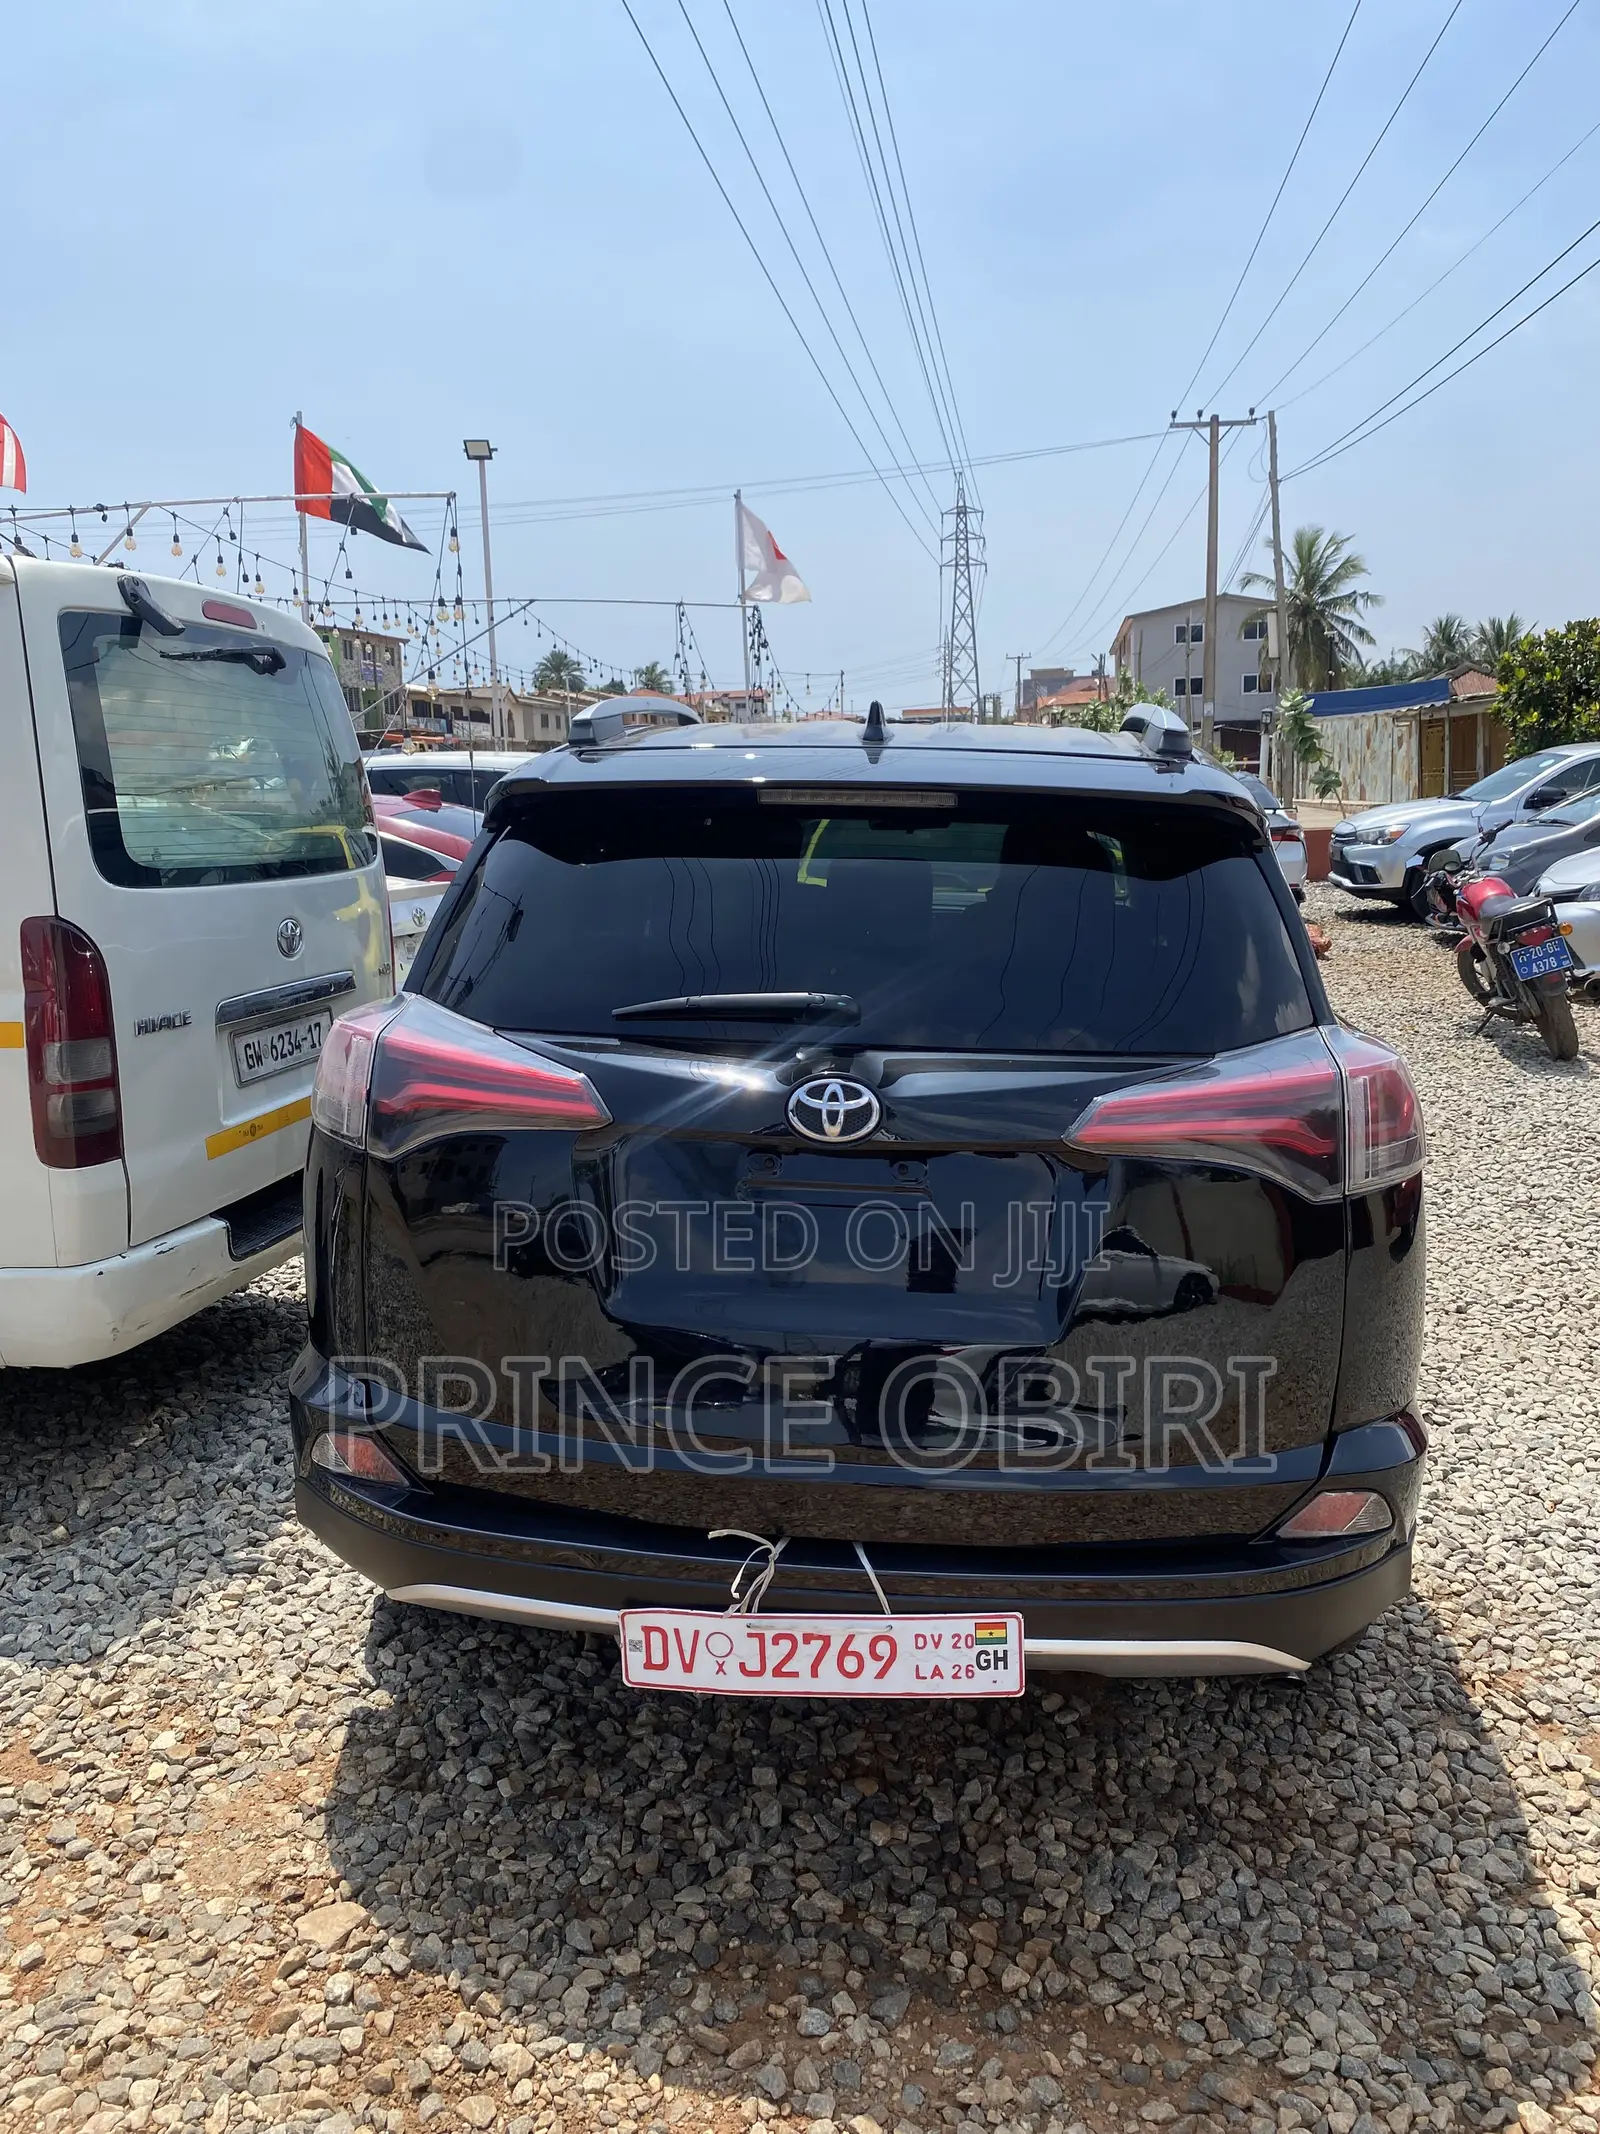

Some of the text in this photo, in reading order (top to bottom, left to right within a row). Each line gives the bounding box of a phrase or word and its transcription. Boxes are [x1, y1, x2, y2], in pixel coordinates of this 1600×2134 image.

[1531, 956, 1557, 974] 4378
[243, 1021, 322, 1070] GW 6234-17
[914, 1633, 975, 1650] DV 20
[641, 1625, 898, 1680] DV J2769
[975, 1649, 1009, 1671] GH
[915, 1664, 975, 1680] LA 26
